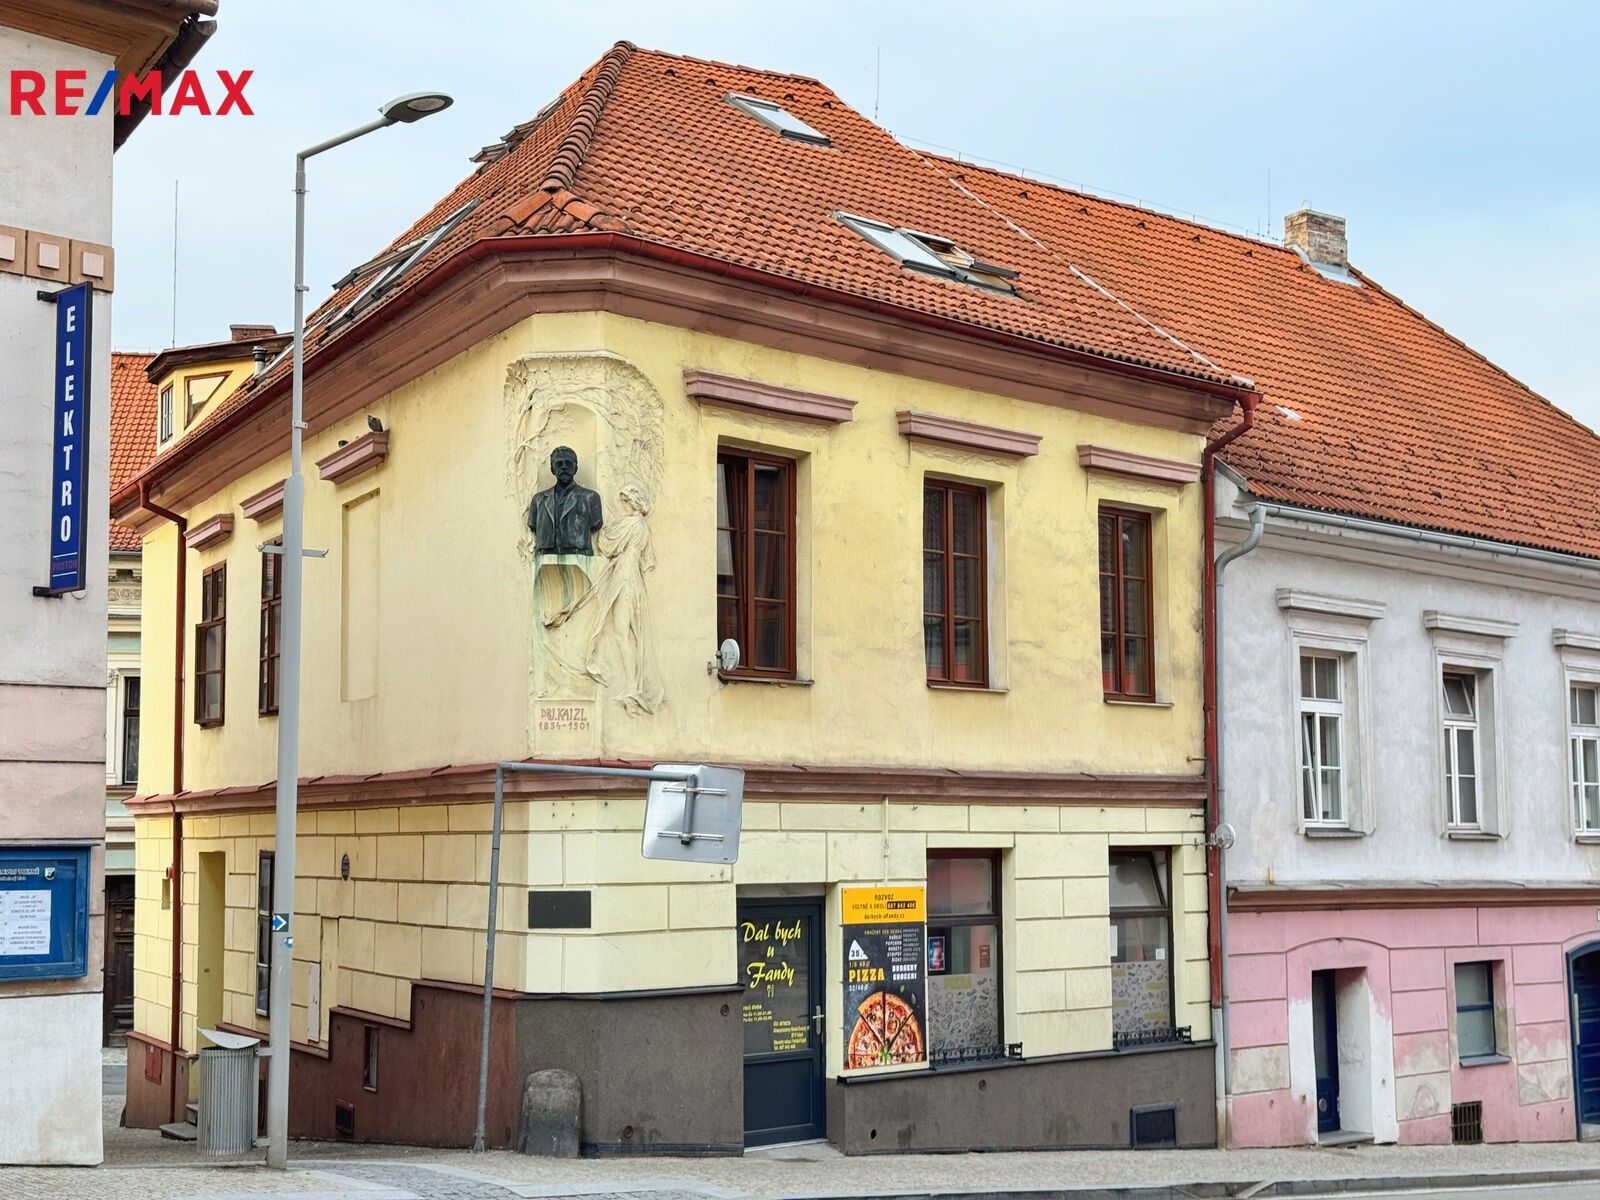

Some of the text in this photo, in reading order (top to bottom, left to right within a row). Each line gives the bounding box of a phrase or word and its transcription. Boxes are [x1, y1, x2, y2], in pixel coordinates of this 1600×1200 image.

[60, 306, 76, 542] ELEKTRO
[740, 920, 801, 947] Dal bych
[767, 945, 775, 958] u
[746, 961, 795, 989] Fandy
[848, 968, 885, 982] PIZZA
